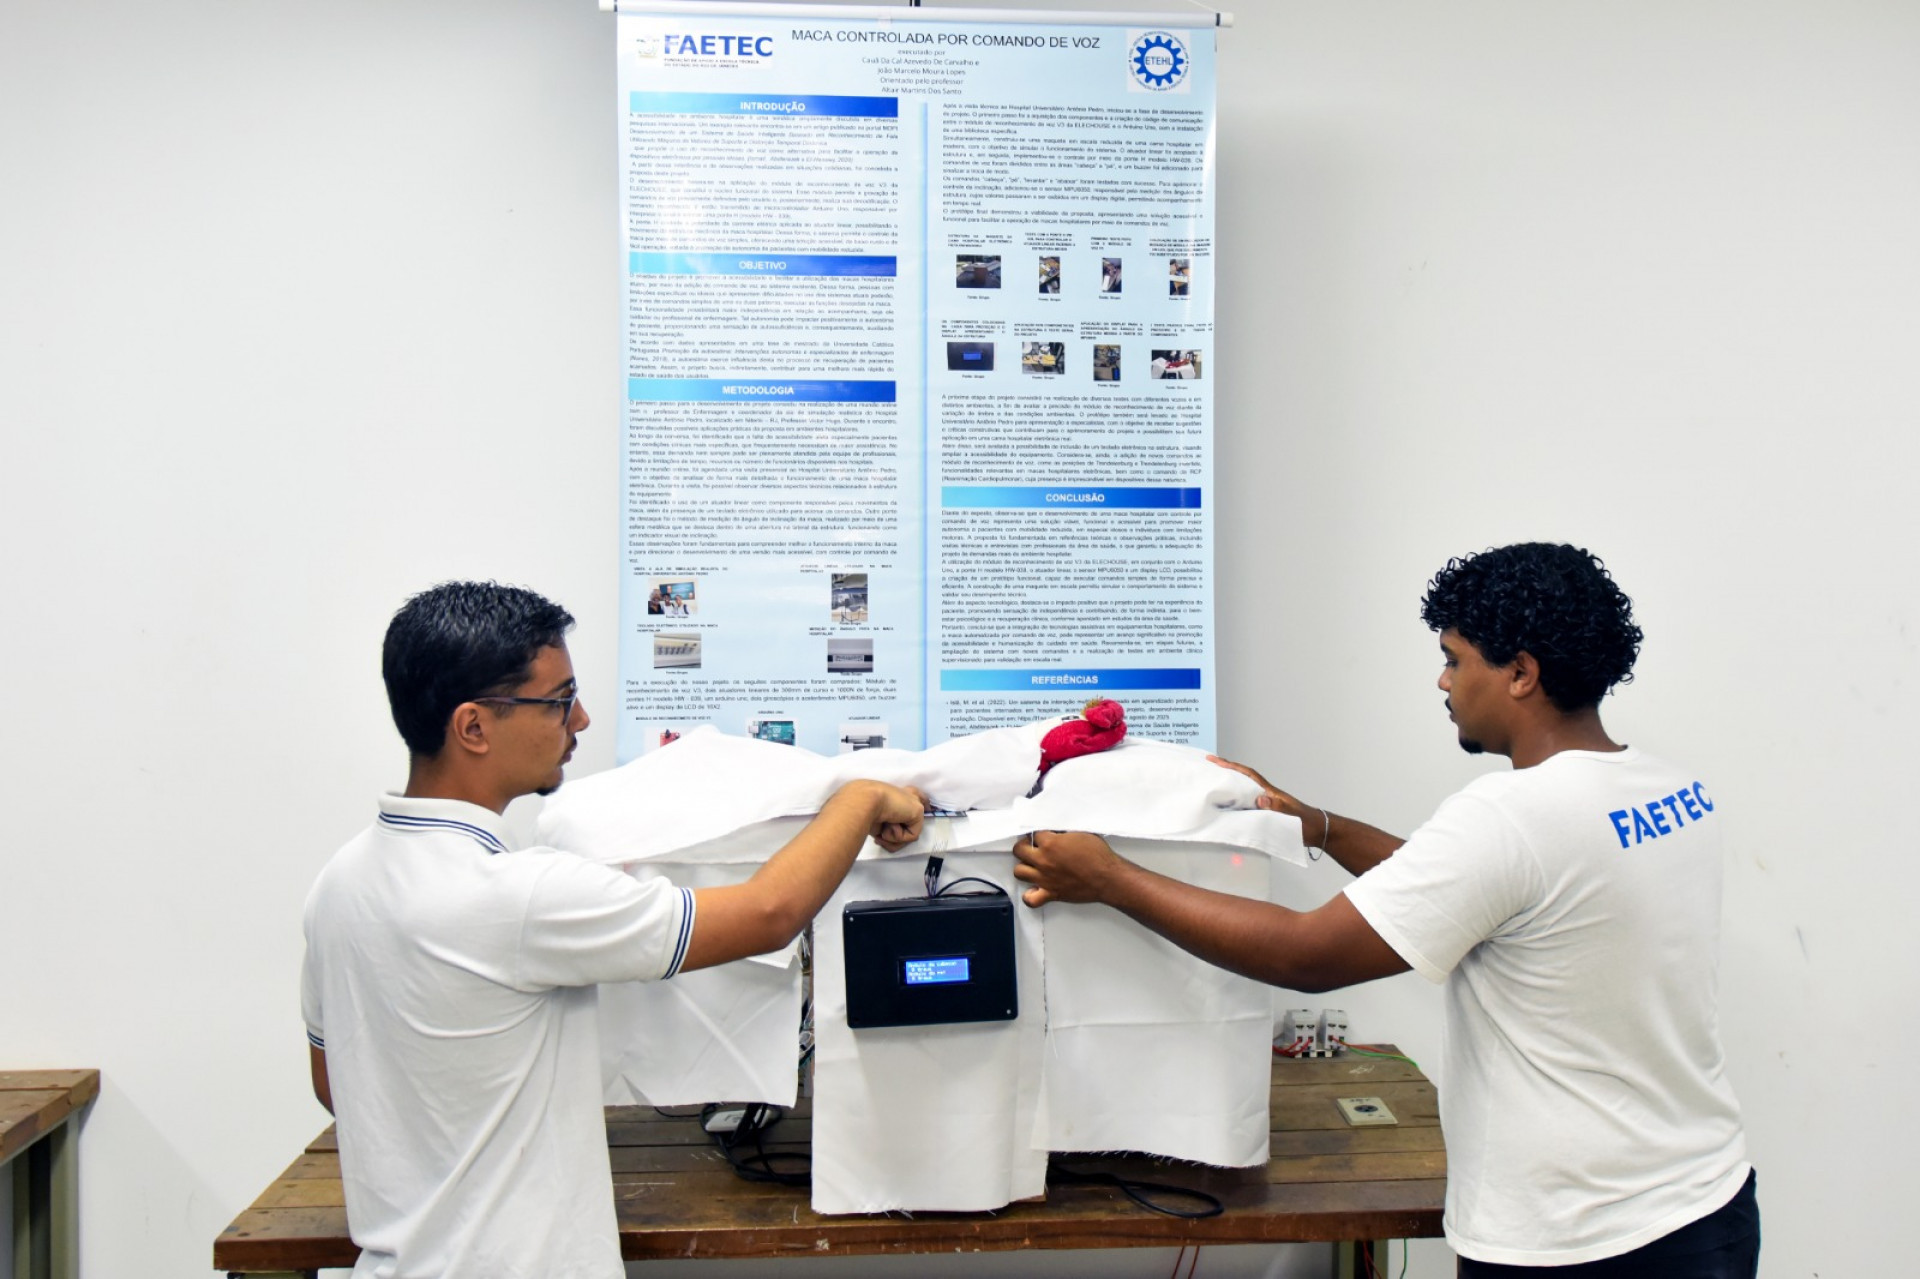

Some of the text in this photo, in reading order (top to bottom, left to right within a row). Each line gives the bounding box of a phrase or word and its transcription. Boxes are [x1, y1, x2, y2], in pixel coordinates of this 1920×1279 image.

[792, 30, 1100, 49] MACA CONTROLADA POR COMANDO DE VOZ
[664, 34, 773, 57] FAETEC
[1145, 56, 1172, 65] ETEHL
[740, 101, 806, 113] INTRODUÇÃO
[739, 261, 787, 270] OBJETIVO
[722, 385, 794, 395] METODOLOGIA
[1045, 493, 1105, 502] CONCLUSÃO
[1031, 675, 1098, 684] REFERÊNCIAS
[1608, 781, 1714, 848] FAETEC
